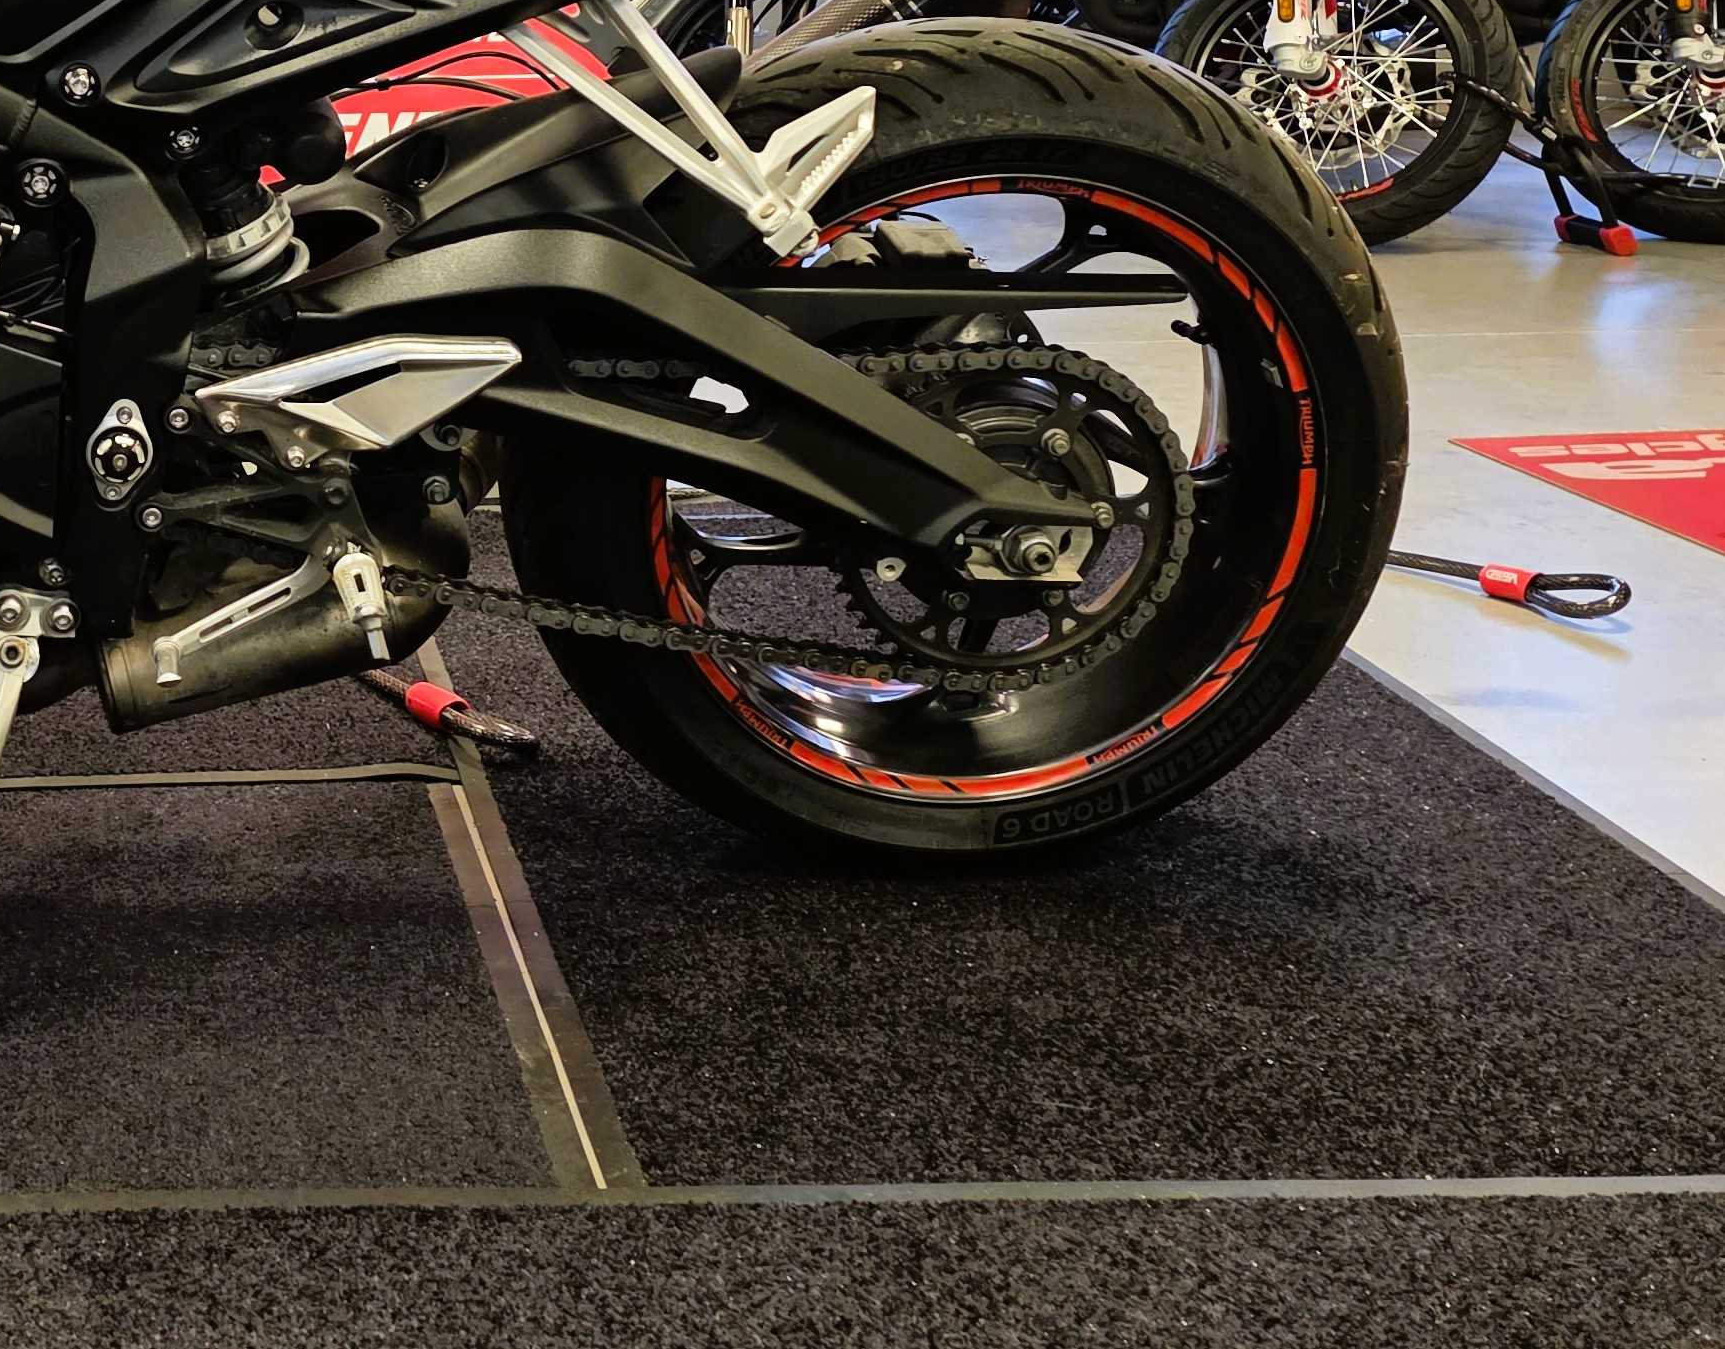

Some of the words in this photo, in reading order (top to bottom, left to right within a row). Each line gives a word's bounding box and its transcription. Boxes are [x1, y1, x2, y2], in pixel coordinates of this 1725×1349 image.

[1298, 396, 1315, 466] TRIUMPH
[1001, 815, 1023, 839] 6
[1029, 791, 1115, 832] ROAD
